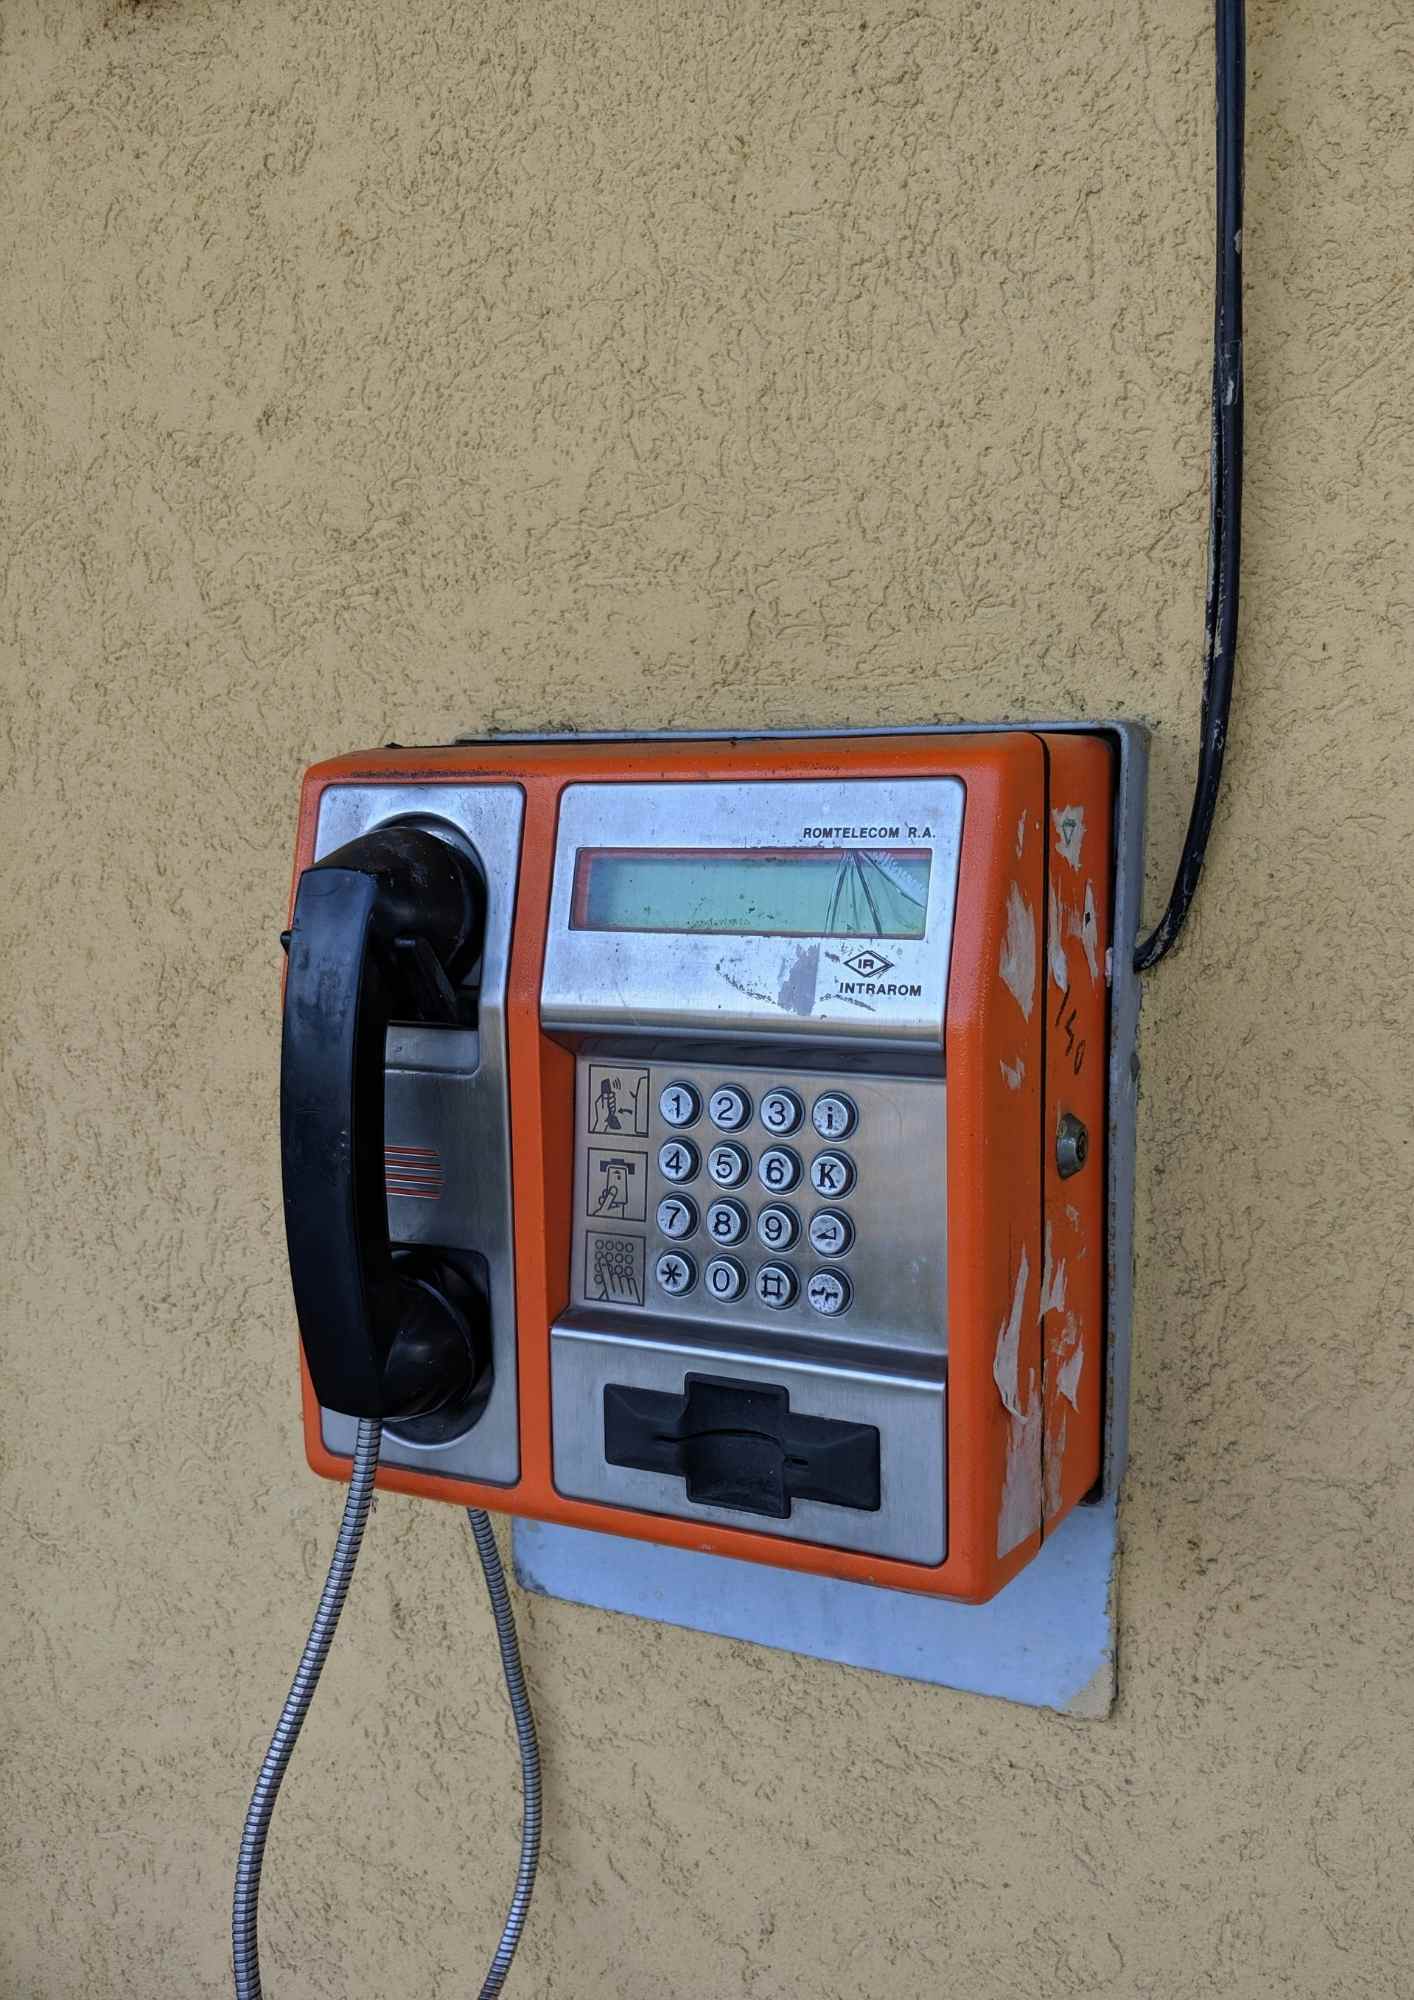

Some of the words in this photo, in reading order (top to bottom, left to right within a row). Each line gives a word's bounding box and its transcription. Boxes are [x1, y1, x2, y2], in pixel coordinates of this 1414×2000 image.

[803, 827, 899, 839] ROMTELECOM
[907, 827, 936, 838] R.A.
[857, 959, 875, 969] IR
[839, 982, 922, 997] INTRAROM
[671, 1094, 681, 1118] 1
[716, 1097, 733, 1121] 2
[769, 1101, 785, 1126] 3
[665, 1151, 682, 1175] 4
[715, 1154, 733, 1179] 5
[766, 1159, 784, 1184] 6
[817, 1163, 837, 1189] K
[665, 1206, 681, 1229] 7
[713, 1211, 731, 1236] 8
[765, 1216, 782, 1241] 9
[712, 1267, 730, 1292] 0
